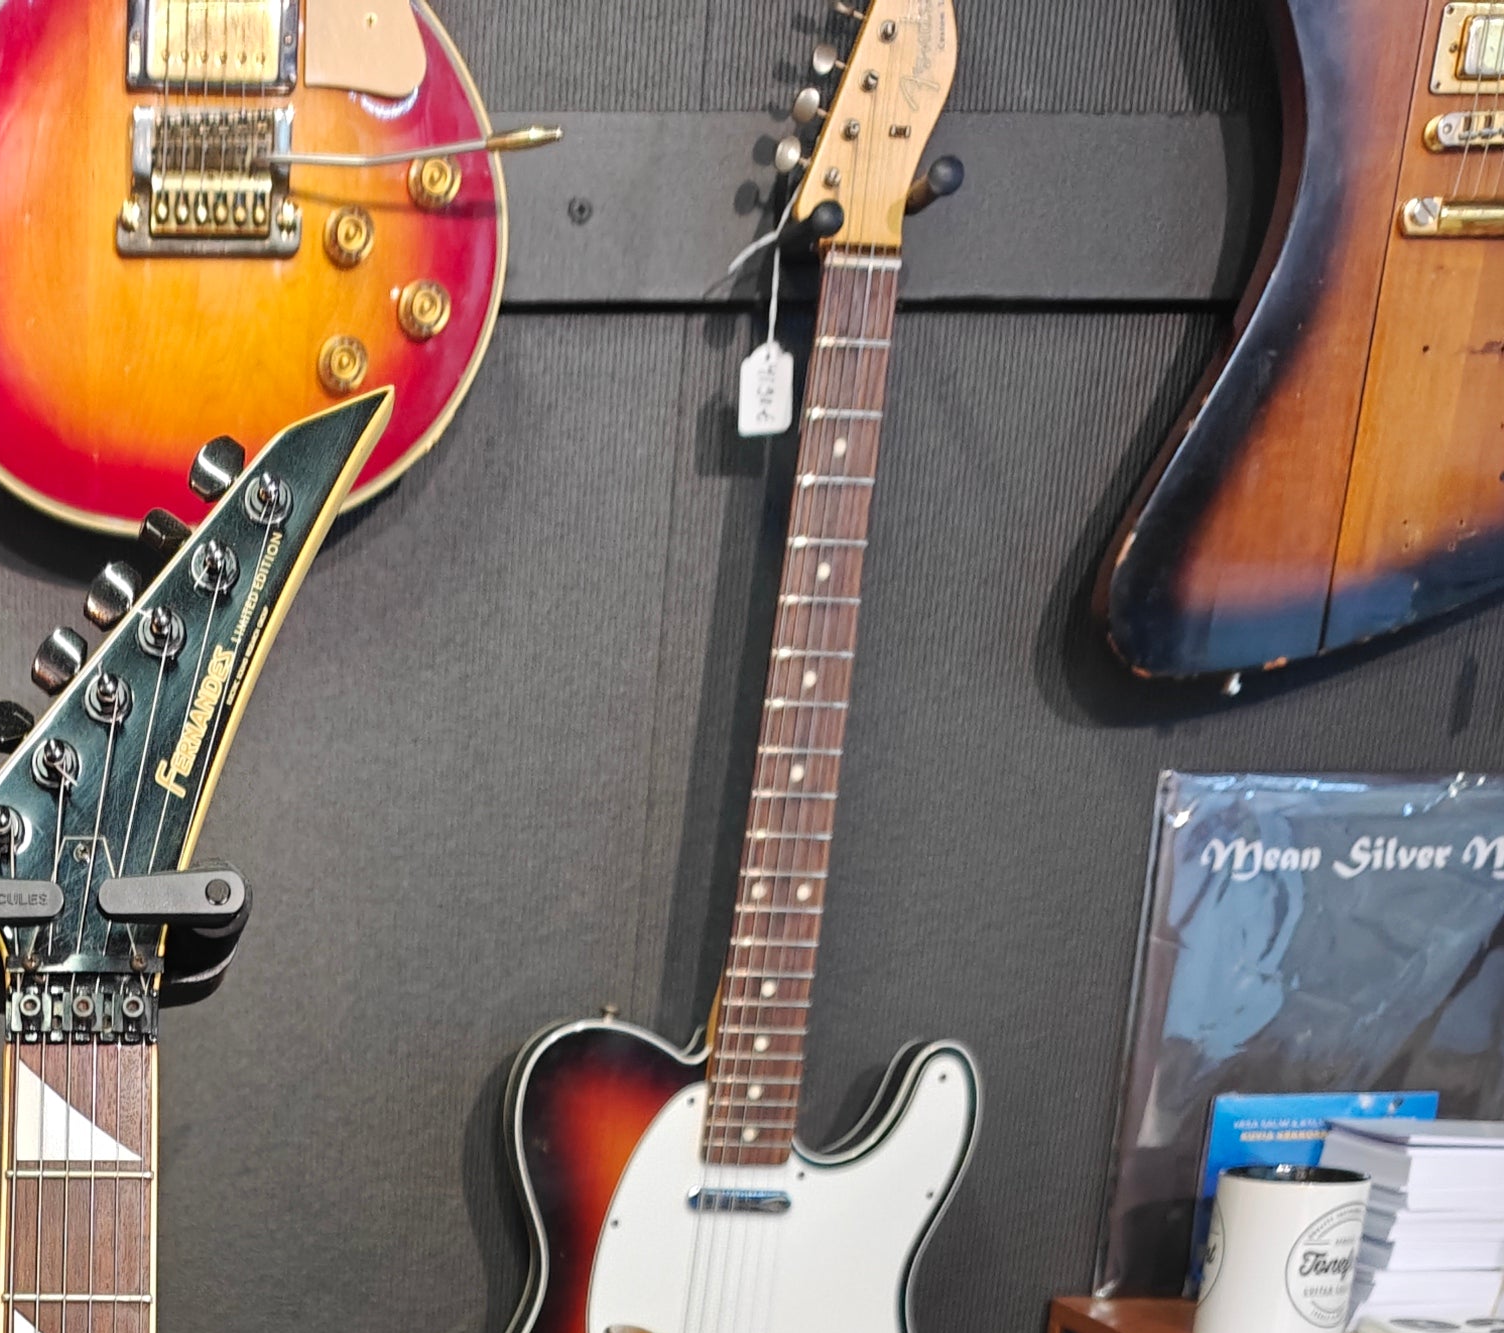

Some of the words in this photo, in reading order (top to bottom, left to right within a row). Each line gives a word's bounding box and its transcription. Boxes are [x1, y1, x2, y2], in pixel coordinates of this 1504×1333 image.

[231, 591, 259, 645] LIMITED
[253, 532, 284, 593] EDITION
[154, 644, 235, 800] FERNANDES
[1200, 836, 1323, 881] Mean
[1332, 835, 1454, 880] Silver
